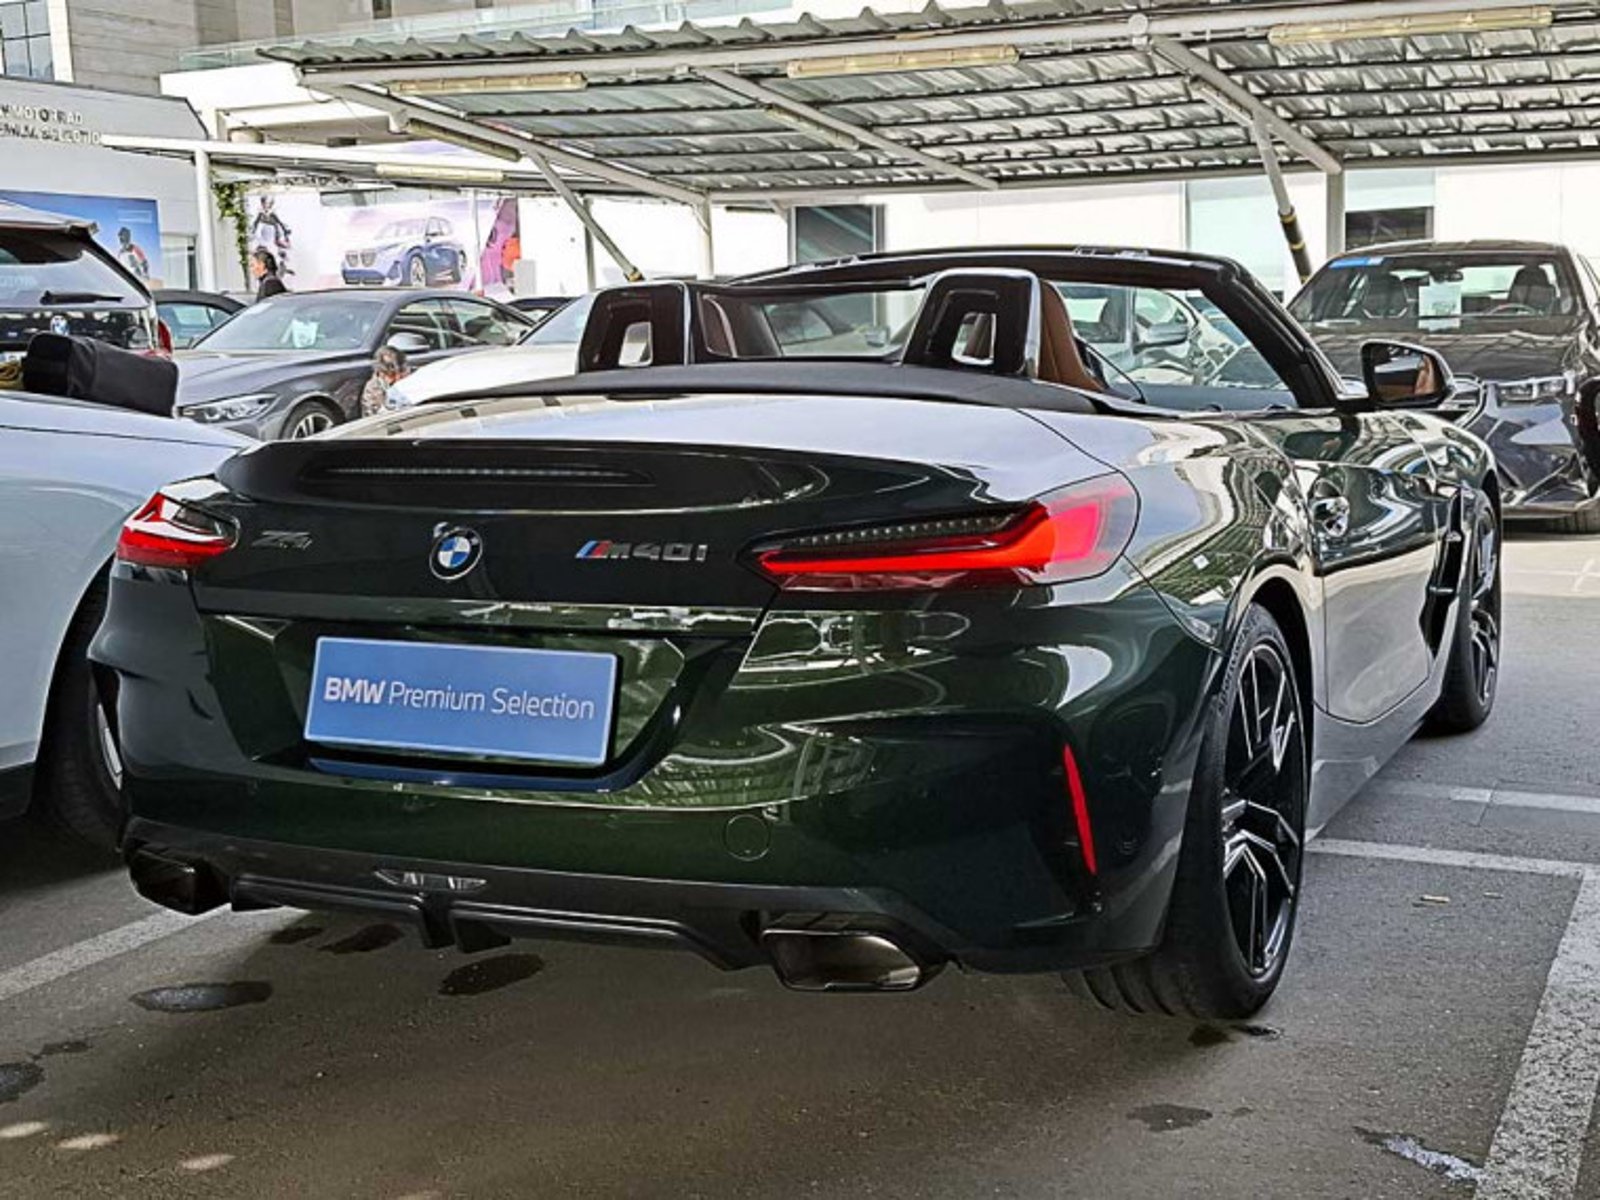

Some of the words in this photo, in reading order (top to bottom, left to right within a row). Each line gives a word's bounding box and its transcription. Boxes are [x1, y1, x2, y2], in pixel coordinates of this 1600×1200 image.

[324, 677, 387, 704] BMW
[388, 681, 485, 712] Premium
[491, 688, 594, 720] Selection
